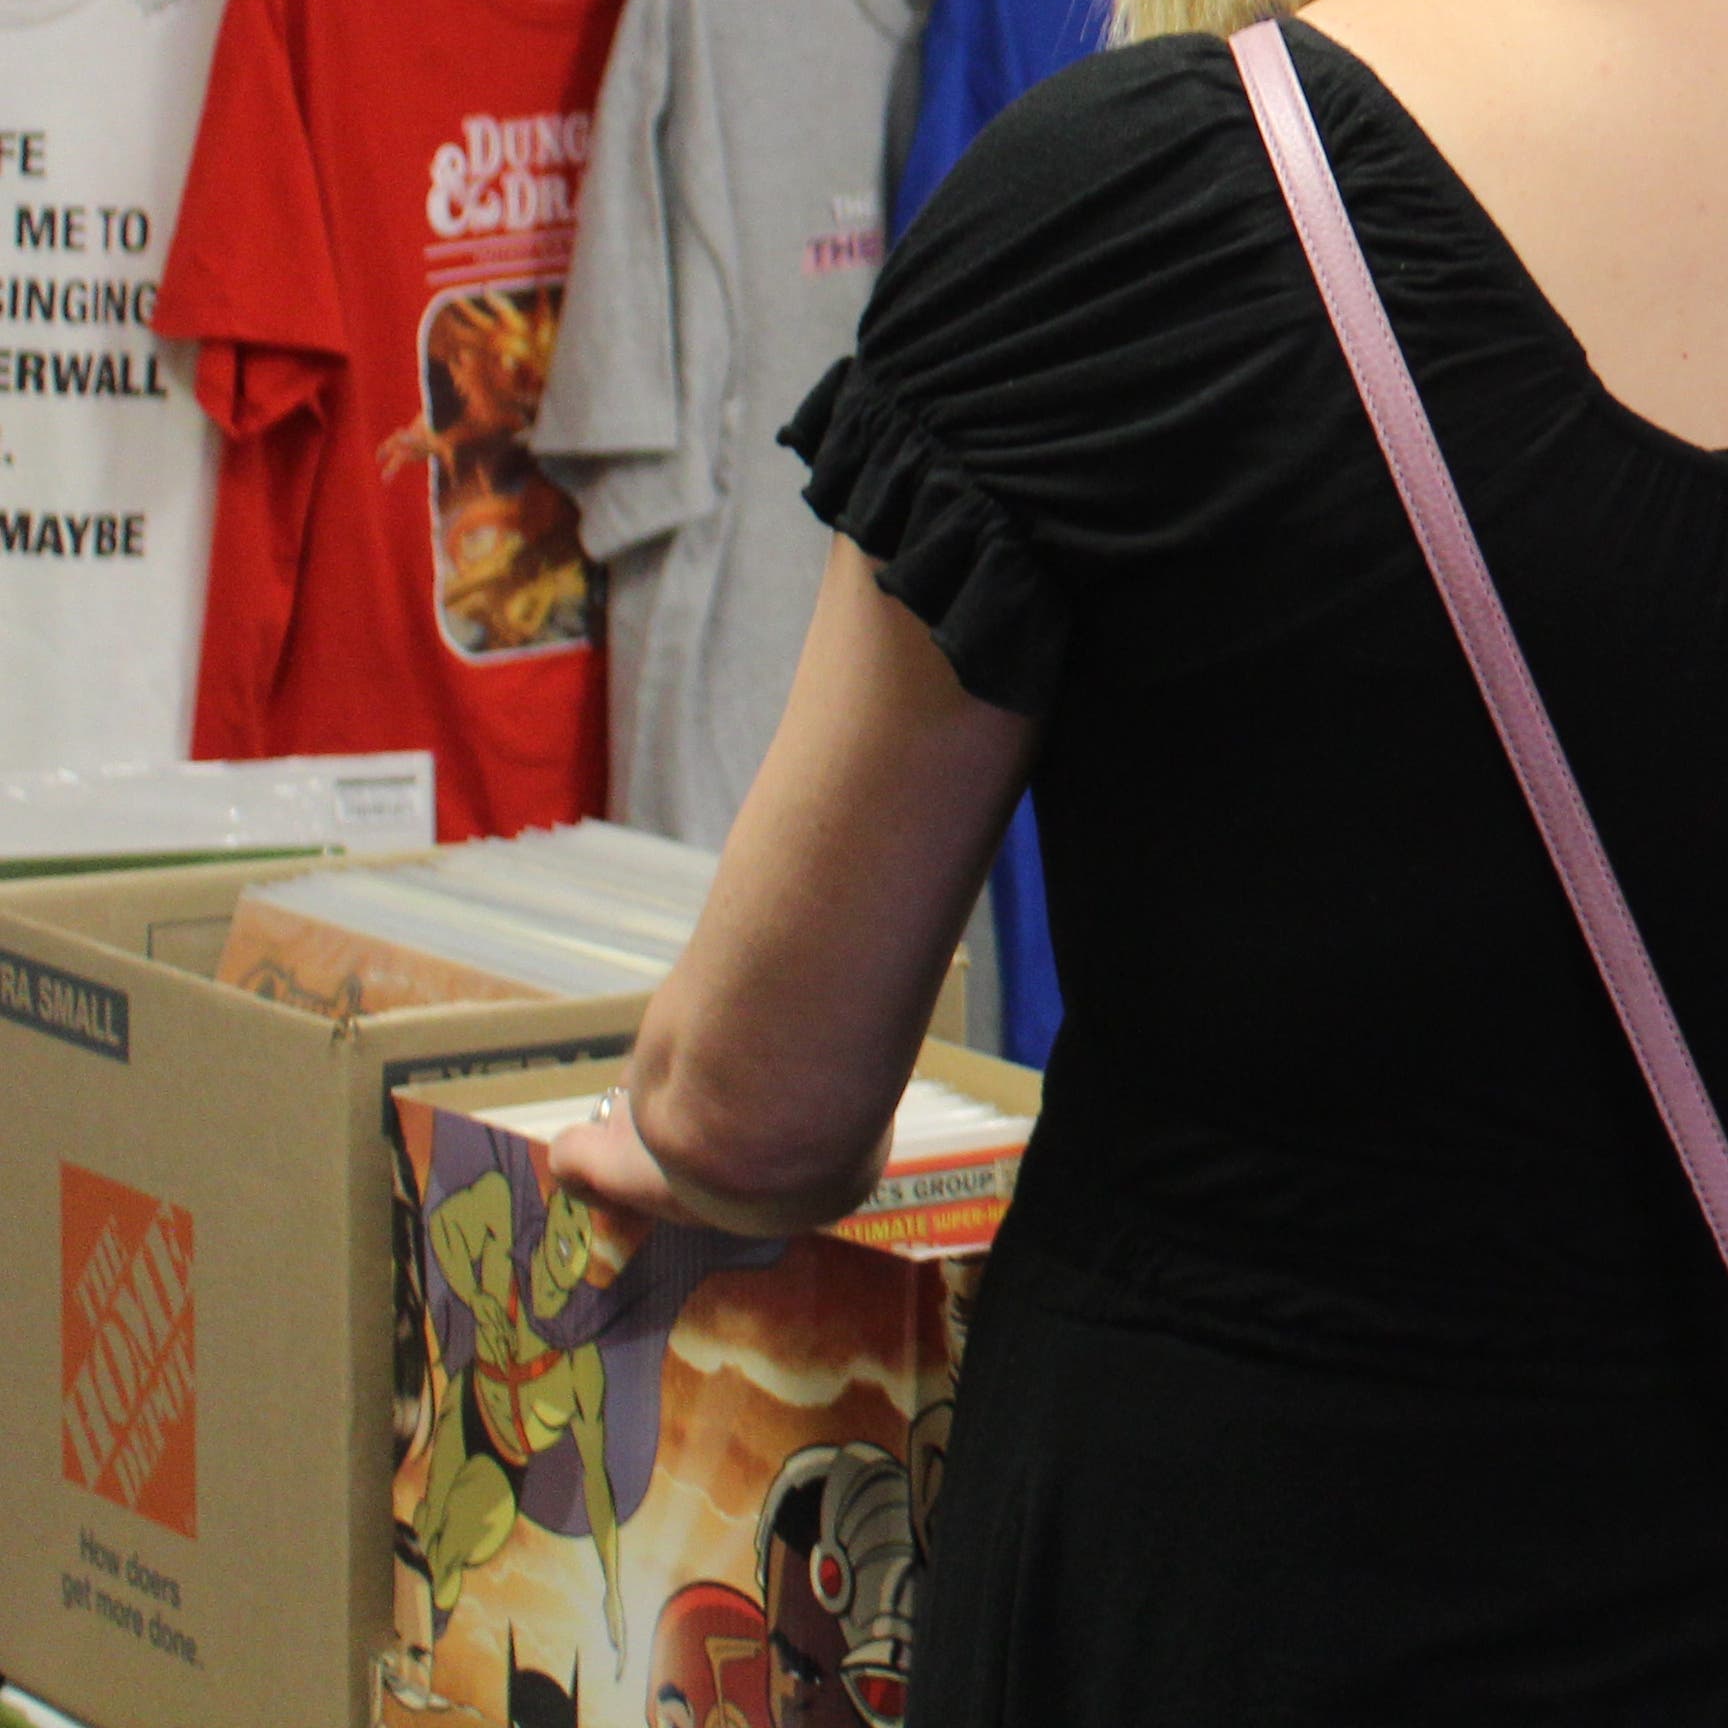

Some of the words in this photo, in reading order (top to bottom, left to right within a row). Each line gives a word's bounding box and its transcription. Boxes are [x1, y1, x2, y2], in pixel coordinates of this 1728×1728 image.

[15, 206, 86, 252] ME
[99, 206, 150, 253] TO
[37, 974, 121, 1048] SMALL
[912, 1165, 995, 1204] GROUP
[64, 1200, 190, 1488] HOME
[112, 1314, 197, 1508] DEPOT
[79, 1524, 120, 1576] How
[125, 1550, 181, 1610] doers
[61, 1572, 93, 1611] get
[96, 1590, 144, 1638] more
